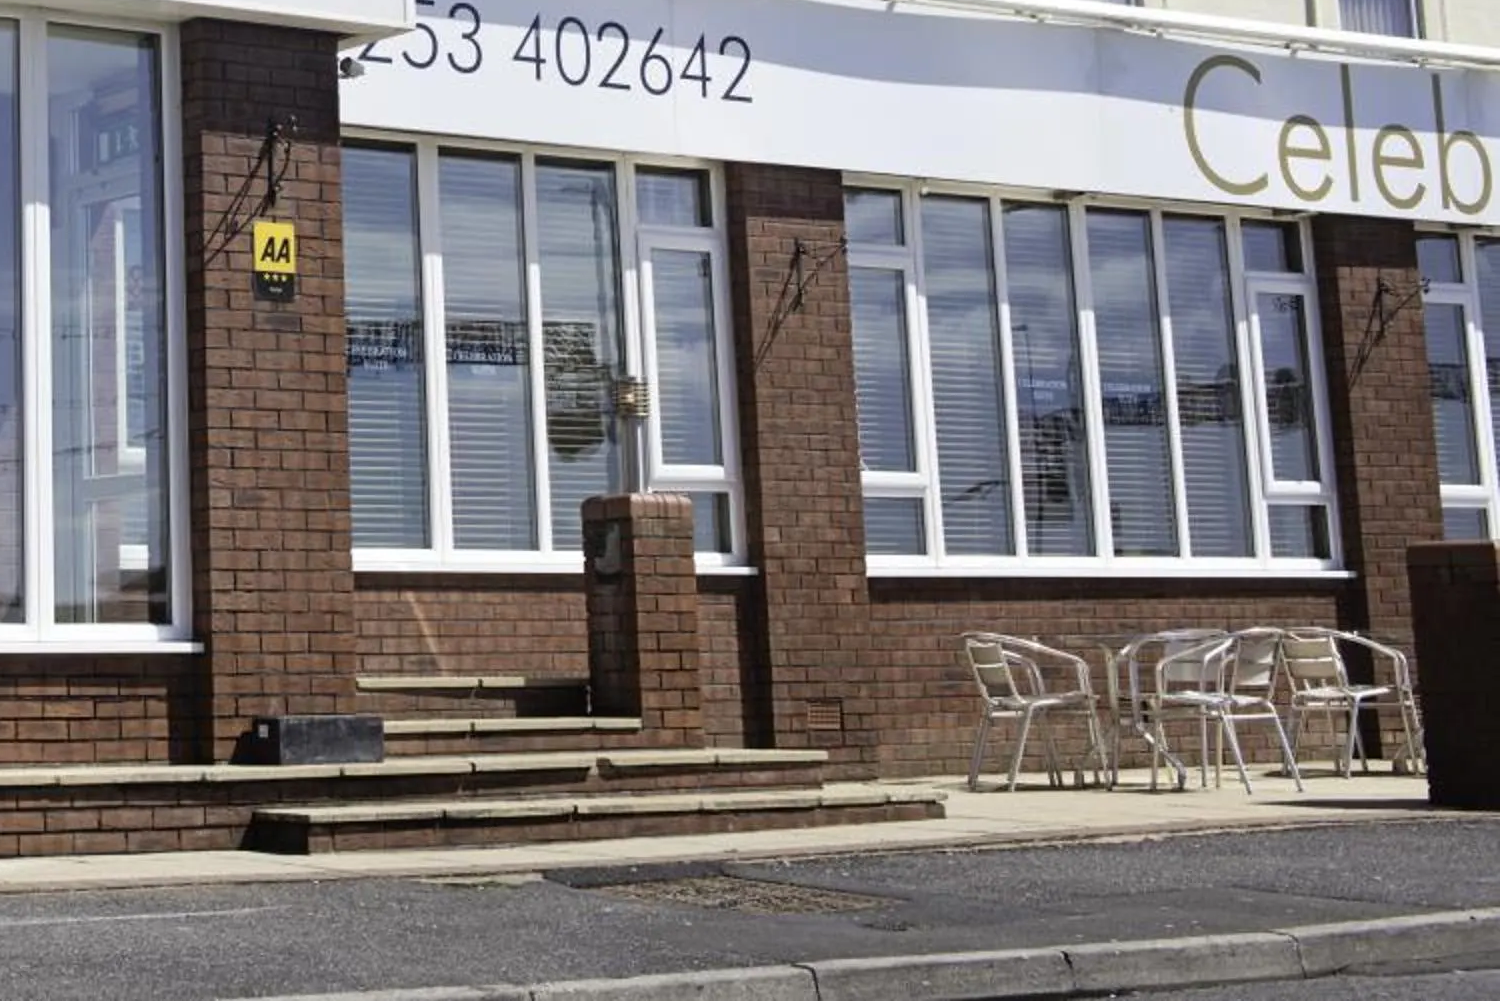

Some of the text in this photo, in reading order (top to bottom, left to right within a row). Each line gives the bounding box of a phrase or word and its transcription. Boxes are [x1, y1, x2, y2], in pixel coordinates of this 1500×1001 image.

[512, 14, 753, 103] 402642
[1183, 54, 1493, 215] Celeb
[260, 236, 291, 264] AA
